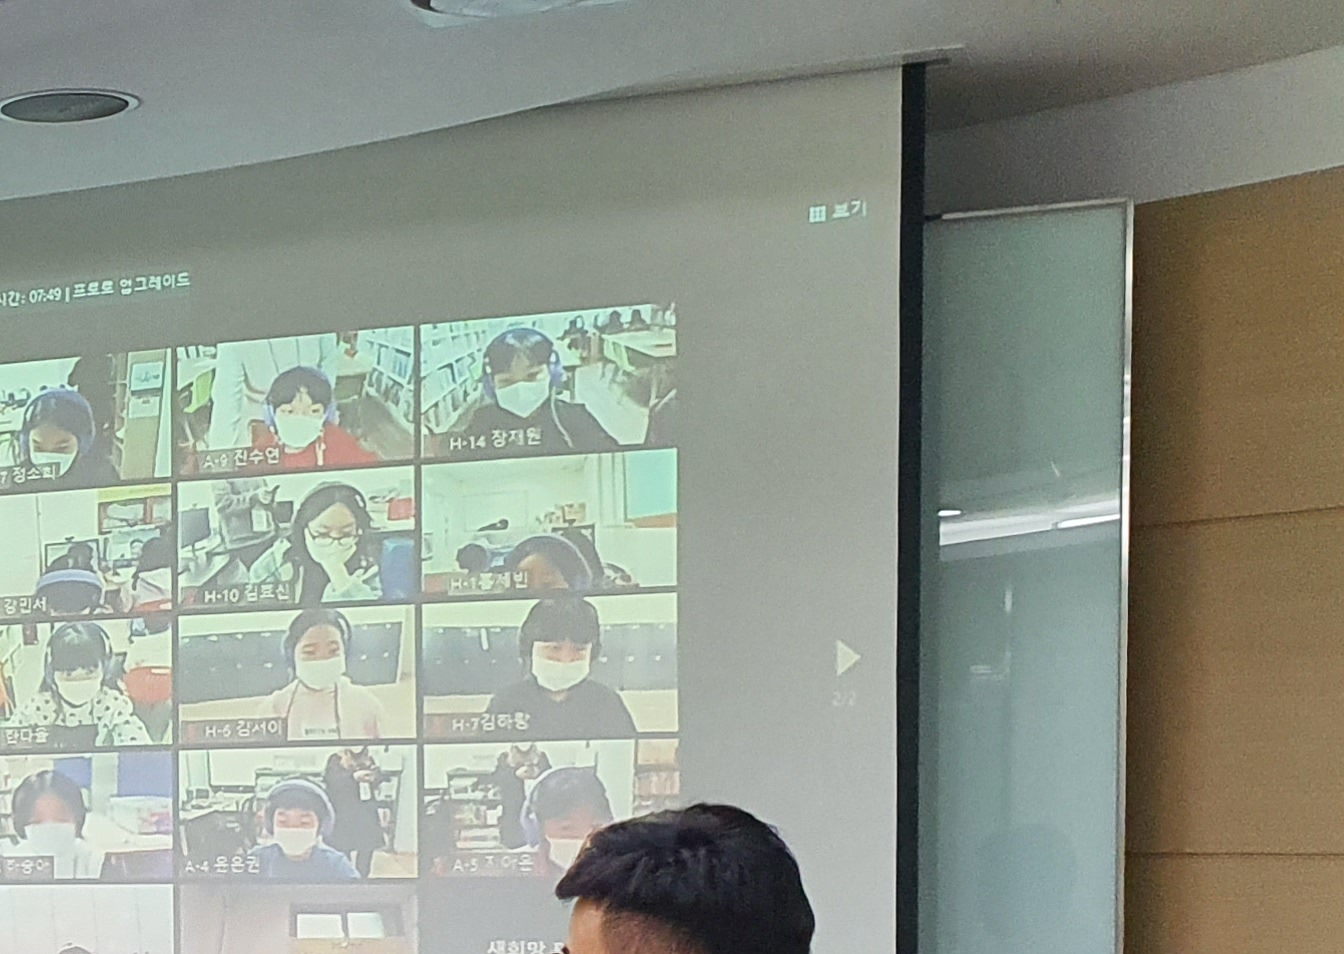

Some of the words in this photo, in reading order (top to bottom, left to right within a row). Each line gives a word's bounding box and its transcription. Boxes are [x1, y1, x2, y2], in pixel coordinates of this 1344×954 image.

[831, 199, 867, 219] 보기
[28, 286, 62, 304] 07:49
[72, 279, 115, 298] 프로로
[119, 271, 191, 296] 업그레이드
[448, 436, 487, 451] H-14
[233, 447, 280, 467] 진수연
[204, 588, 240, 604] H-10
[243, 582, 290, 603] 김효신
[3, 597, 48, 616] 강민서
[204, 724, 231, 738] H-6
[236, 720, 282, 738] 김서이
[183, 859, 209, 873] A-4
[451, 857, 479, 873] A-5
